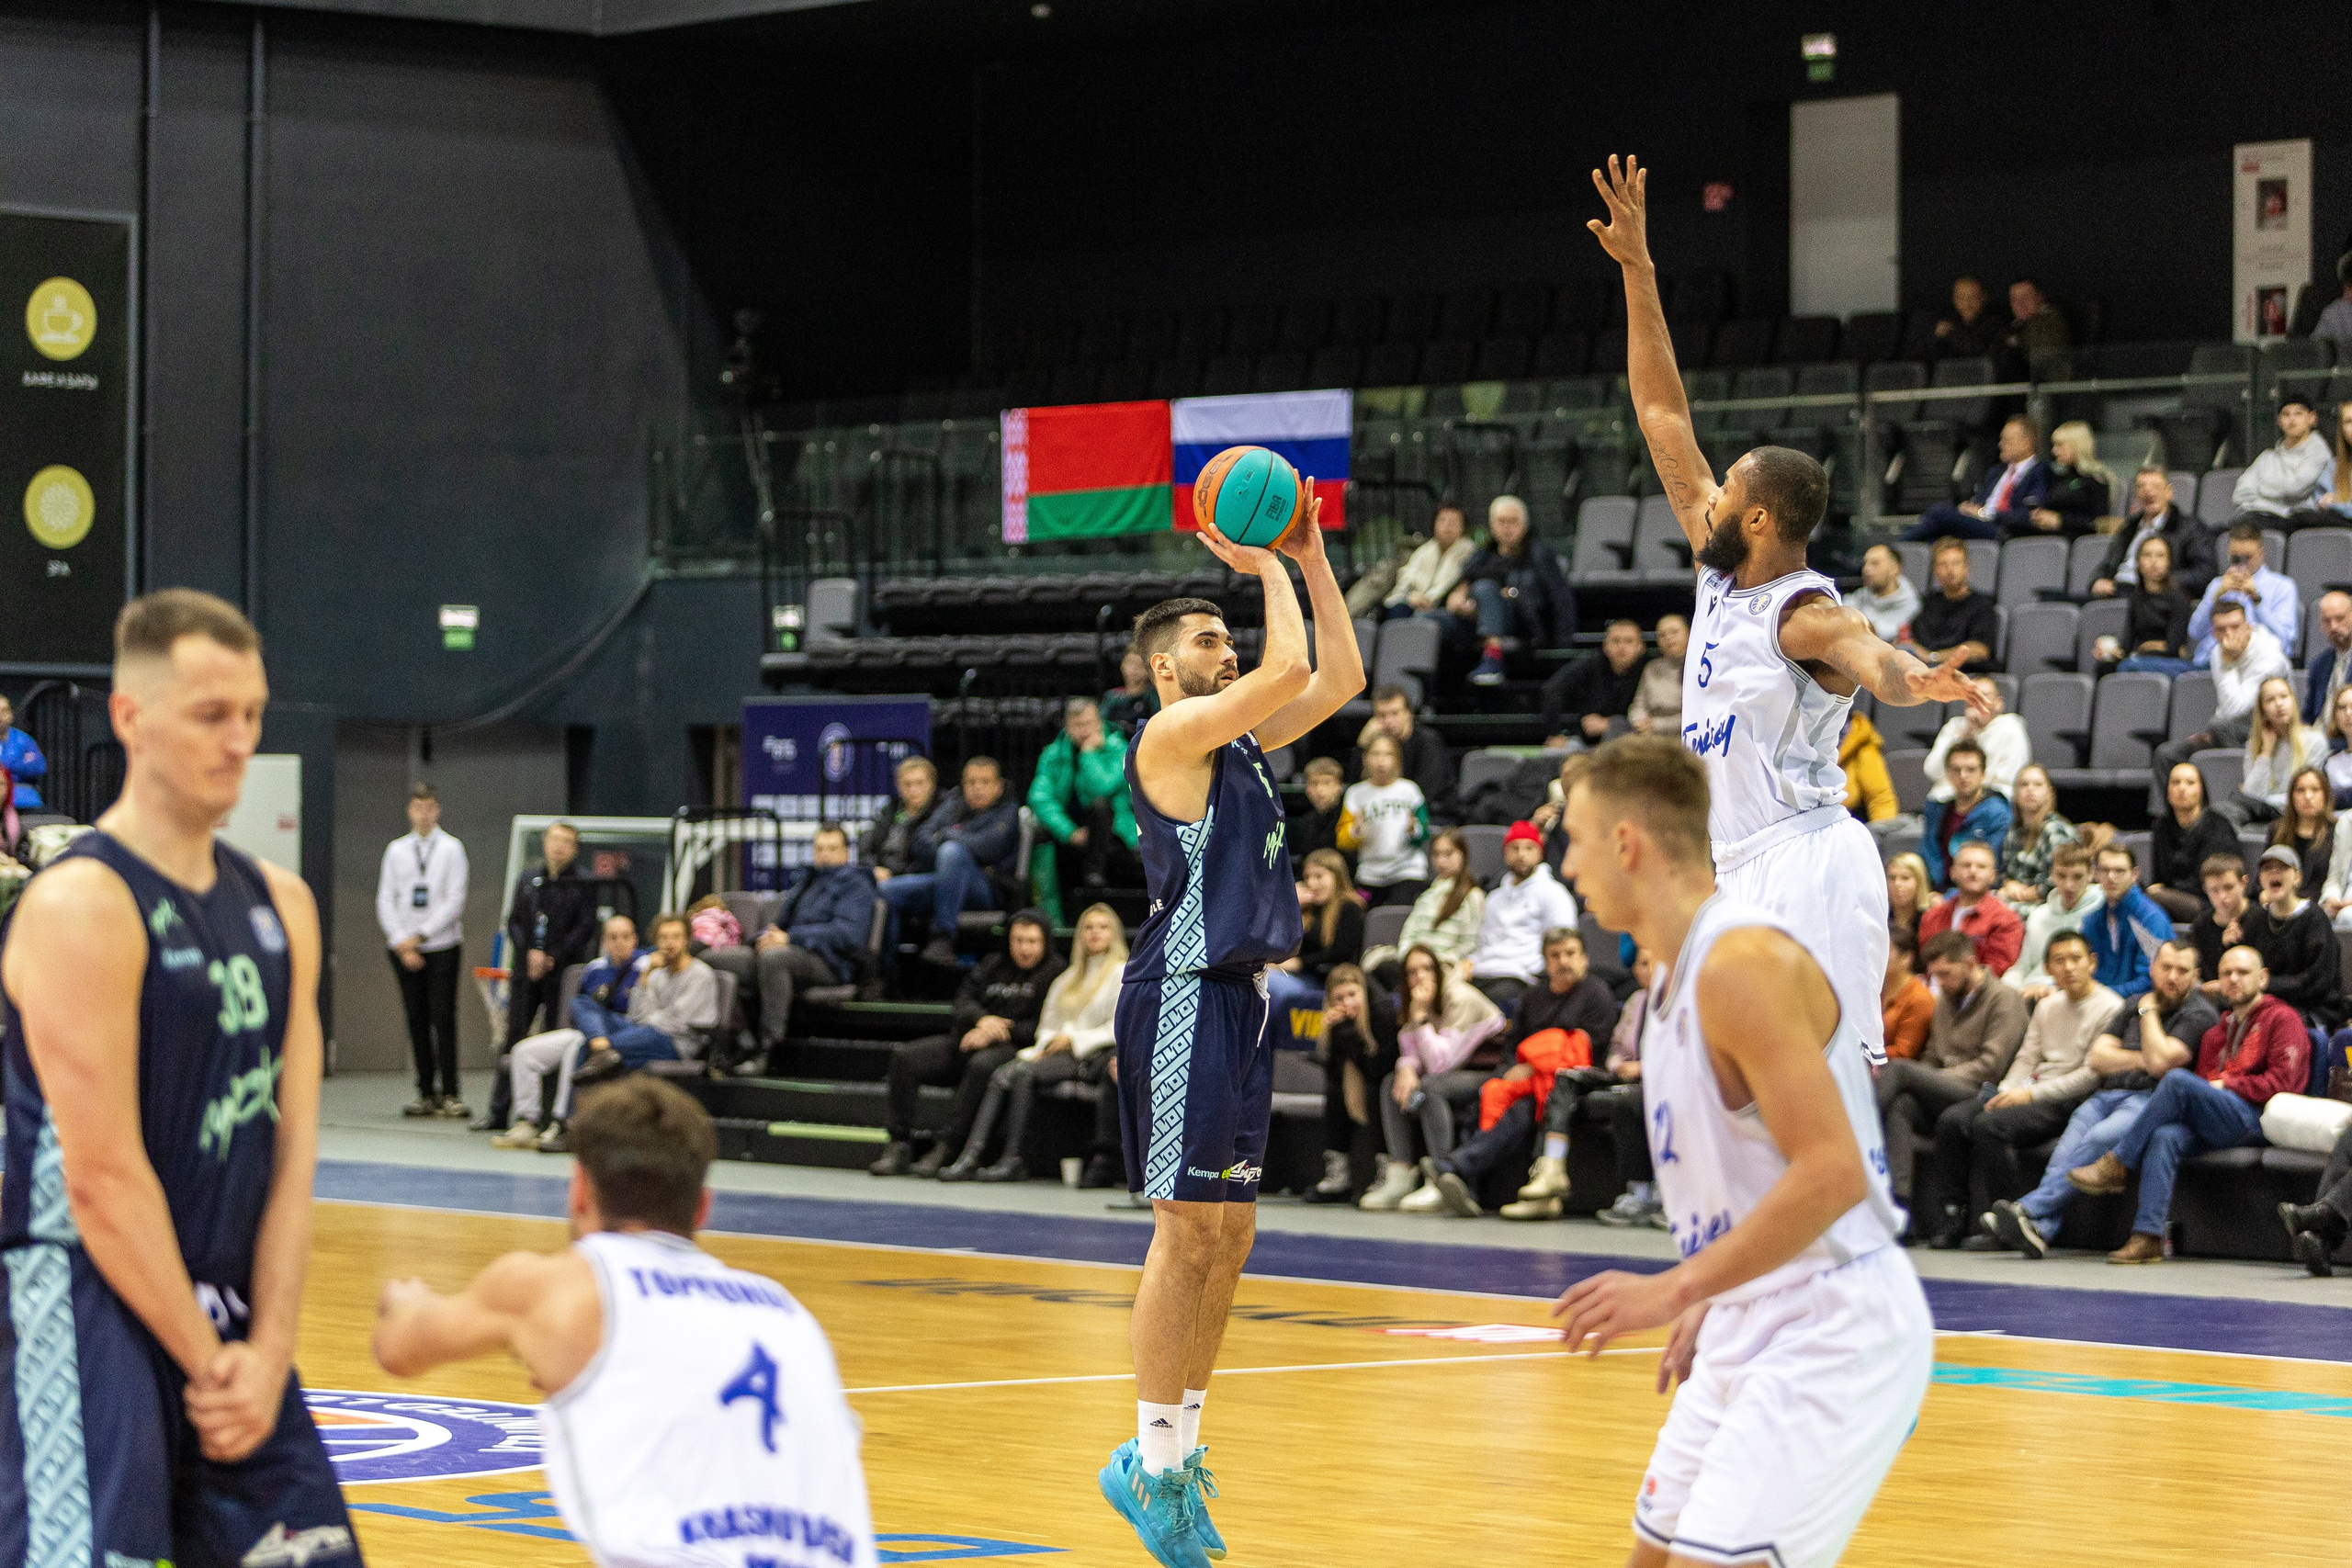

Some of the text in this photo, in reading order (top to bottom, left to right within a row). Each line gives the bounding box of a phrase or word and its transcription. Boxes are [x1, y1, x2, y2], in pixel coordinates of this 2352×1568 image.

[1265, 495, 1283, 521] FIBA
[1698, 641, 1720, 688] 5
[1187, 1166, 1220, 1180] Kempa
